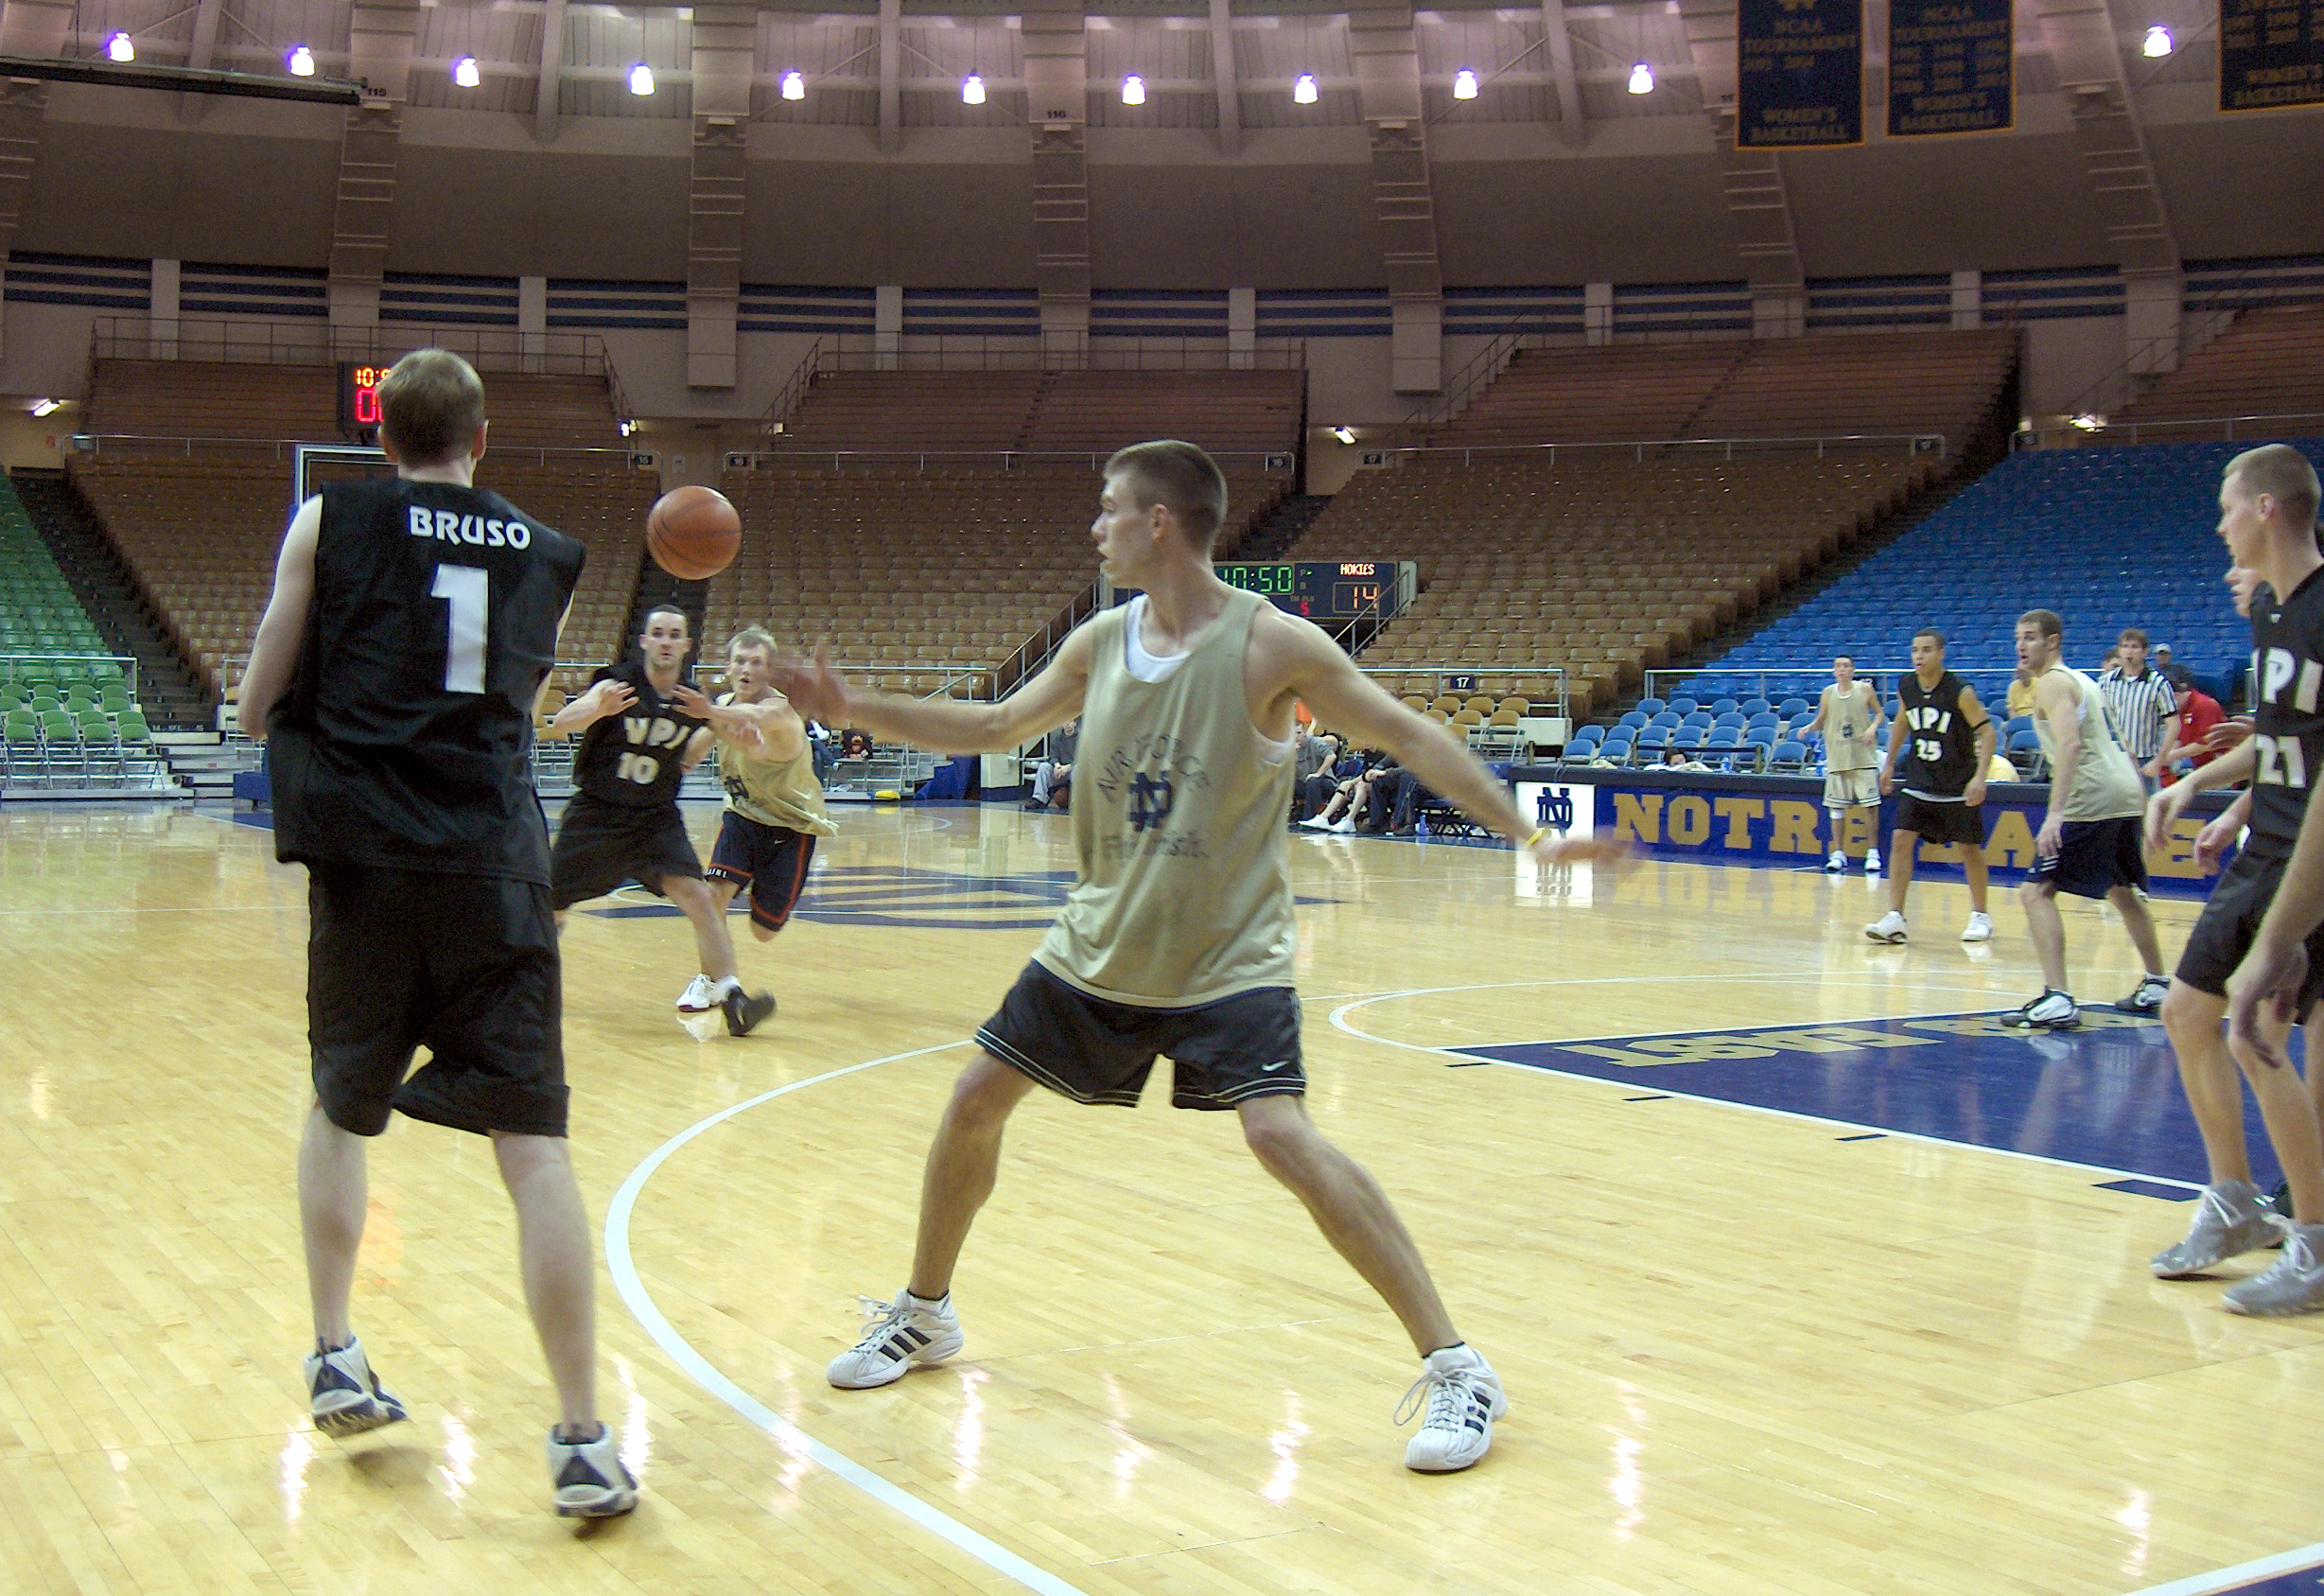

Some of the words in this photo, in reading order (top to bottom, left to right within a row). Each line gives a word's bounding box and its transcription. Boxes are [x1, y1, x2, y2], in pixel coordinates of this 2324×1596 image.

[1774, 19, 1823, 34] NCAA
[1744, 34, 1857, 52] TOURNAMENT
[410, 505, 532, 551] BRUSO
[1339, 563, 1375, 576] HOKIES
[430, 563, 489, 694] 1
[1457, 676, 1470, 689] 17
[623, 715, 692, 750] VPI
[1904, 707, 1952, 735] VPI
[1914, 737, 1943, 763] 25
[2256, 732, 2307, 789] 21
[616, 751, 660, 785] 10
